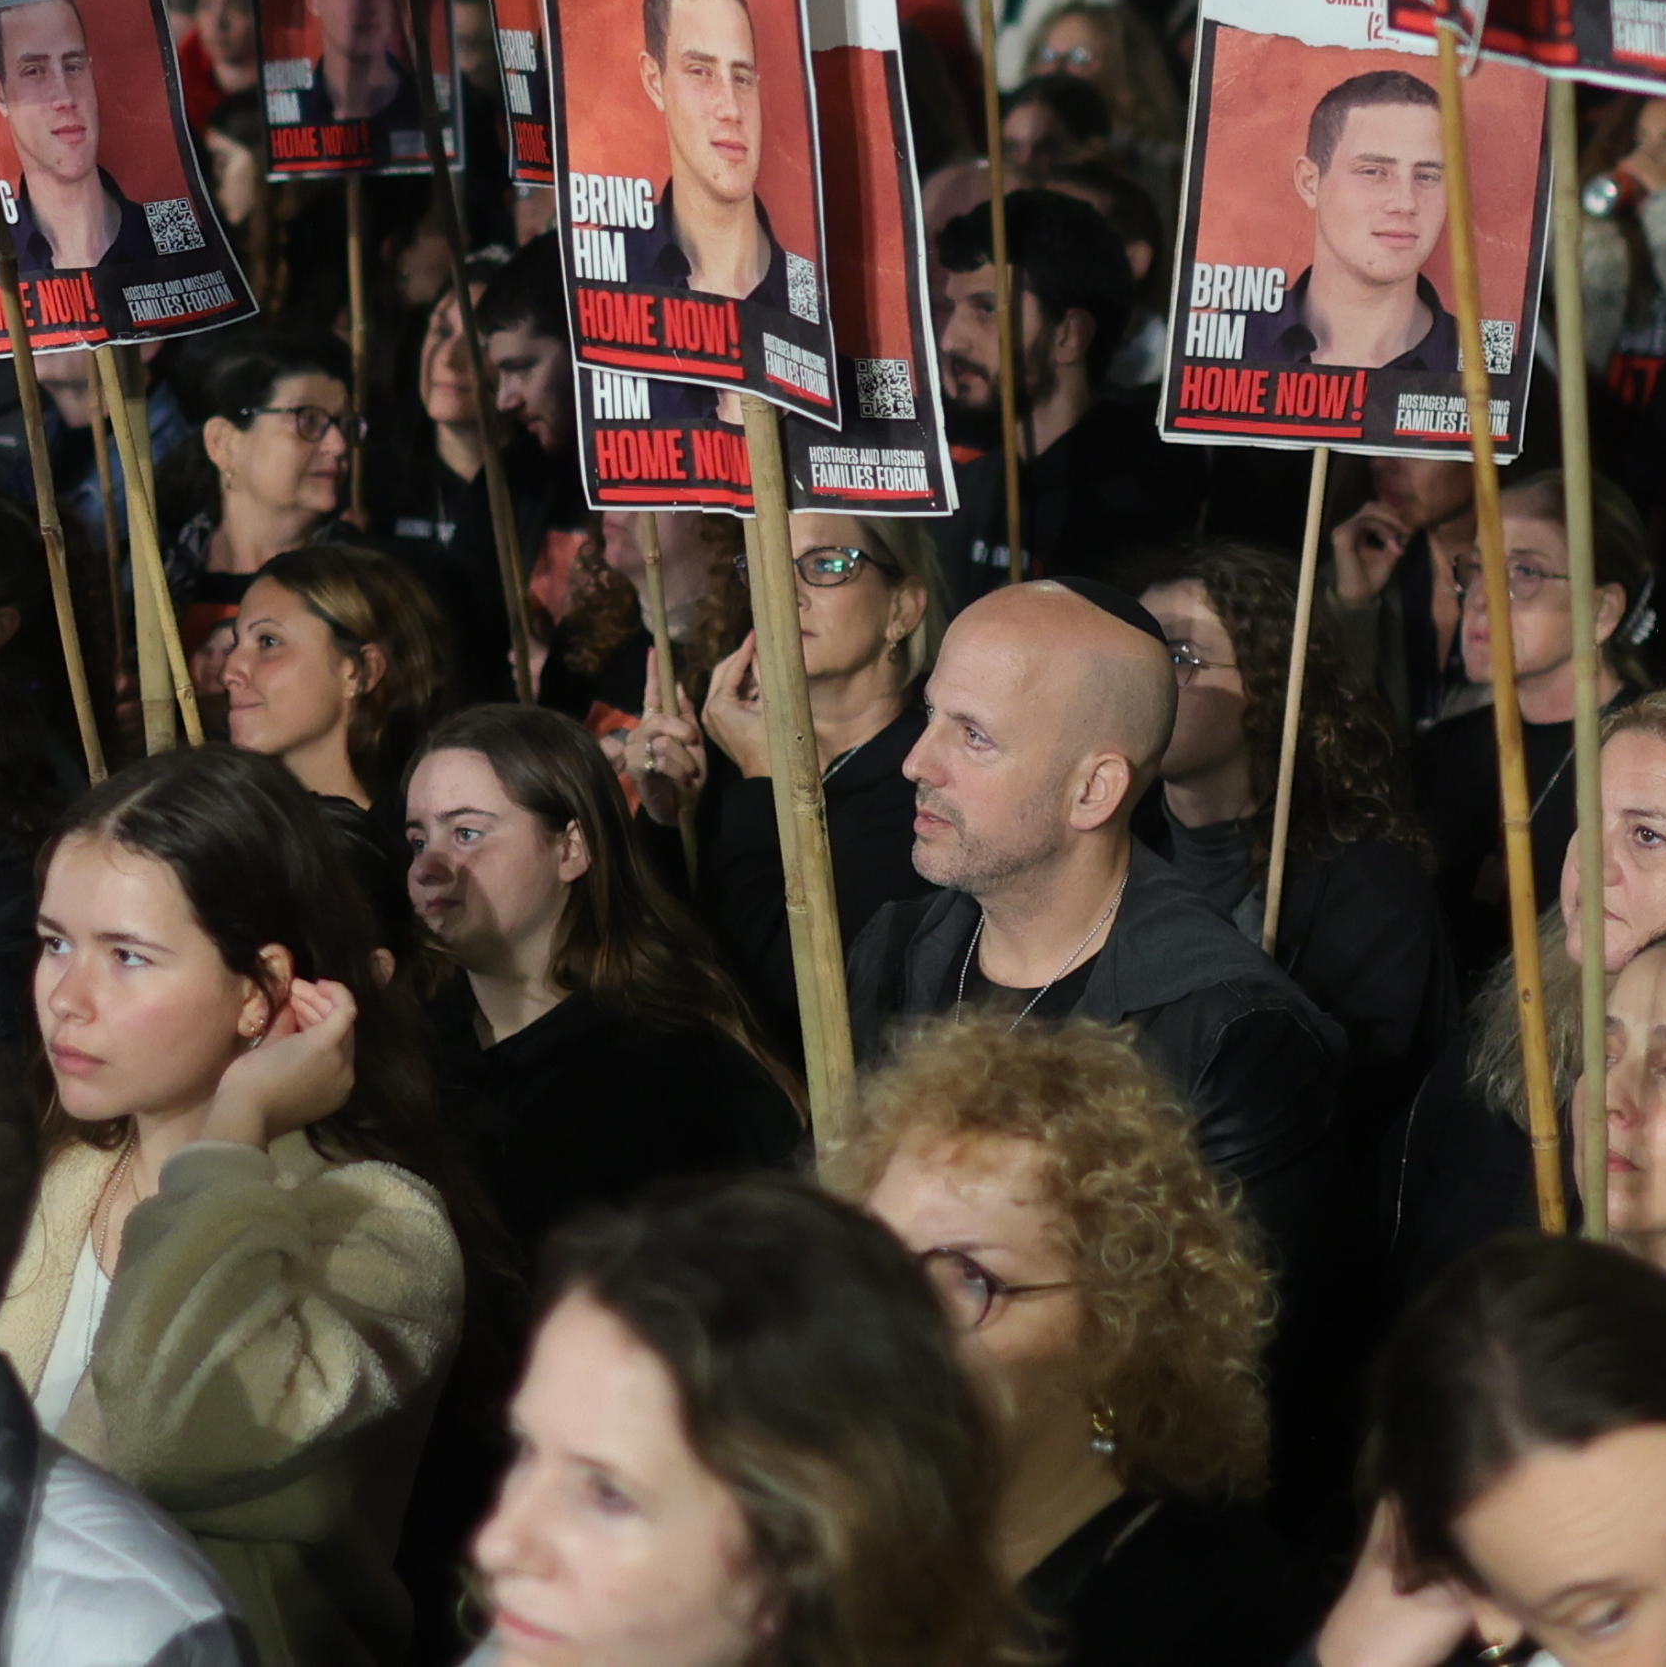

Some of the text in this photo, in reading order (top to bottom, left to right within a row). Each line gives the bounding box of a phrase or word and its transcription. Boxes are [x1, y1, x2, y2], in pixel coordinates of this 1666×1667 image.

[500, 29, 536, 72] BRING
[506, 73, 532, 116] HIM
[515, 122, 551, 164] HOME
[569, 172, 654, 230] BRING
[572, 228, 628, 283] HIM
[35, 270, 99, 327] NOW!
[123, 271, 225, 303] HOSTAGES AND MISSING
[129, 284, 236, 324] FAMILIES FORUM
[1190, 261, 1285, 313] BRING
[577, 288, 742, 359] HOME NOW!
[1184, 312, 1244, 360] HIM
[591, 372, 651, 420] HIM
[765, 350, 831, 400] FAMILIES FORUM
[1179, 364, 1367, 421] HOME NOW!
[1396, 410, 1457, 432] FAMILIES
[1399, 393, 1467, 413] HOSTAGES AND
[596, 429, 687, 481] HOME
[809, 446, 926, 467] HOSTAGES AND MISSING
[811, 464, 929, 492] FAMILIES FORUM
